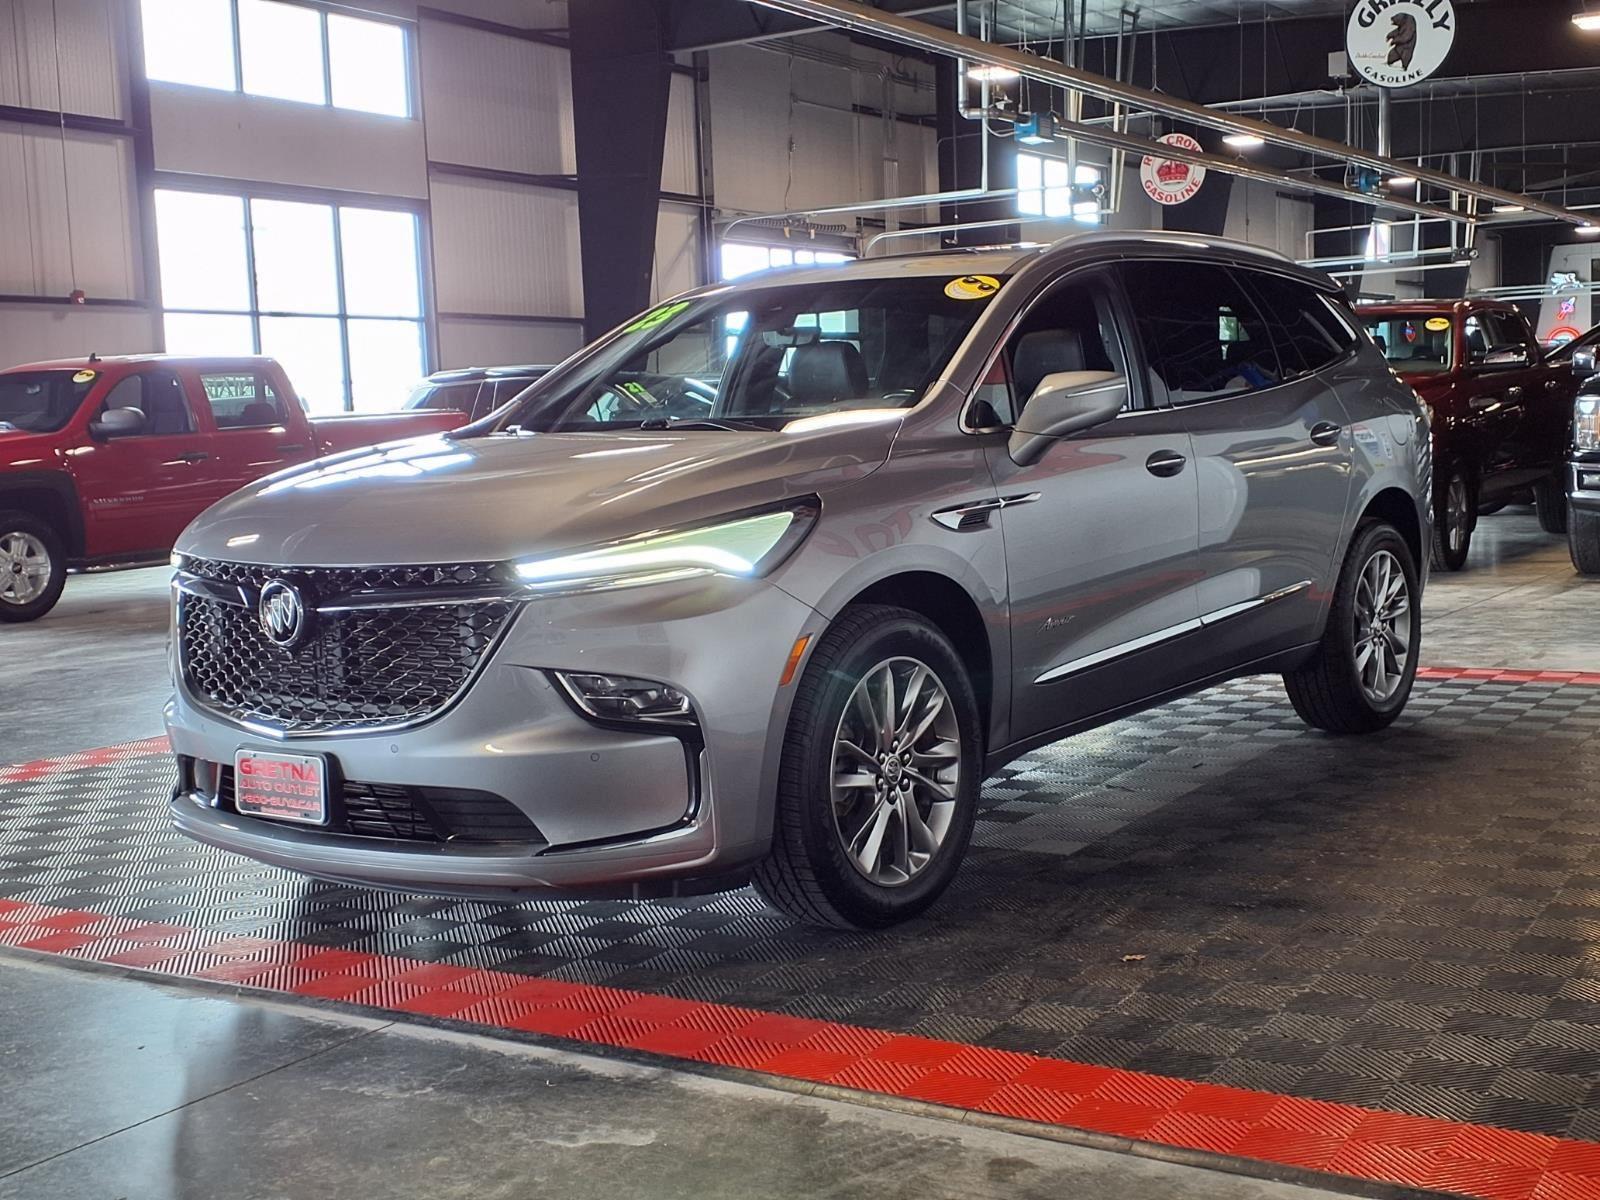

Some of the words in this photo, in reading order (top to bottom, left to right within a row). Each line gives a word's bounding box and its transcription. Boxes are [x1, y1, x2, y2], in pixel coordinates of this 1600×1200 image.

[1358, 0, 1450, 31] GRLY
[1364, 66, 1423, 83] GASOLINE
[1145, 178, 1201, 203] GASOLINE
[239, 758, 319, 784] GRETNA
[239, 778, 273, 792] AUTO
[274, 782, 320, 797] OUTLET
